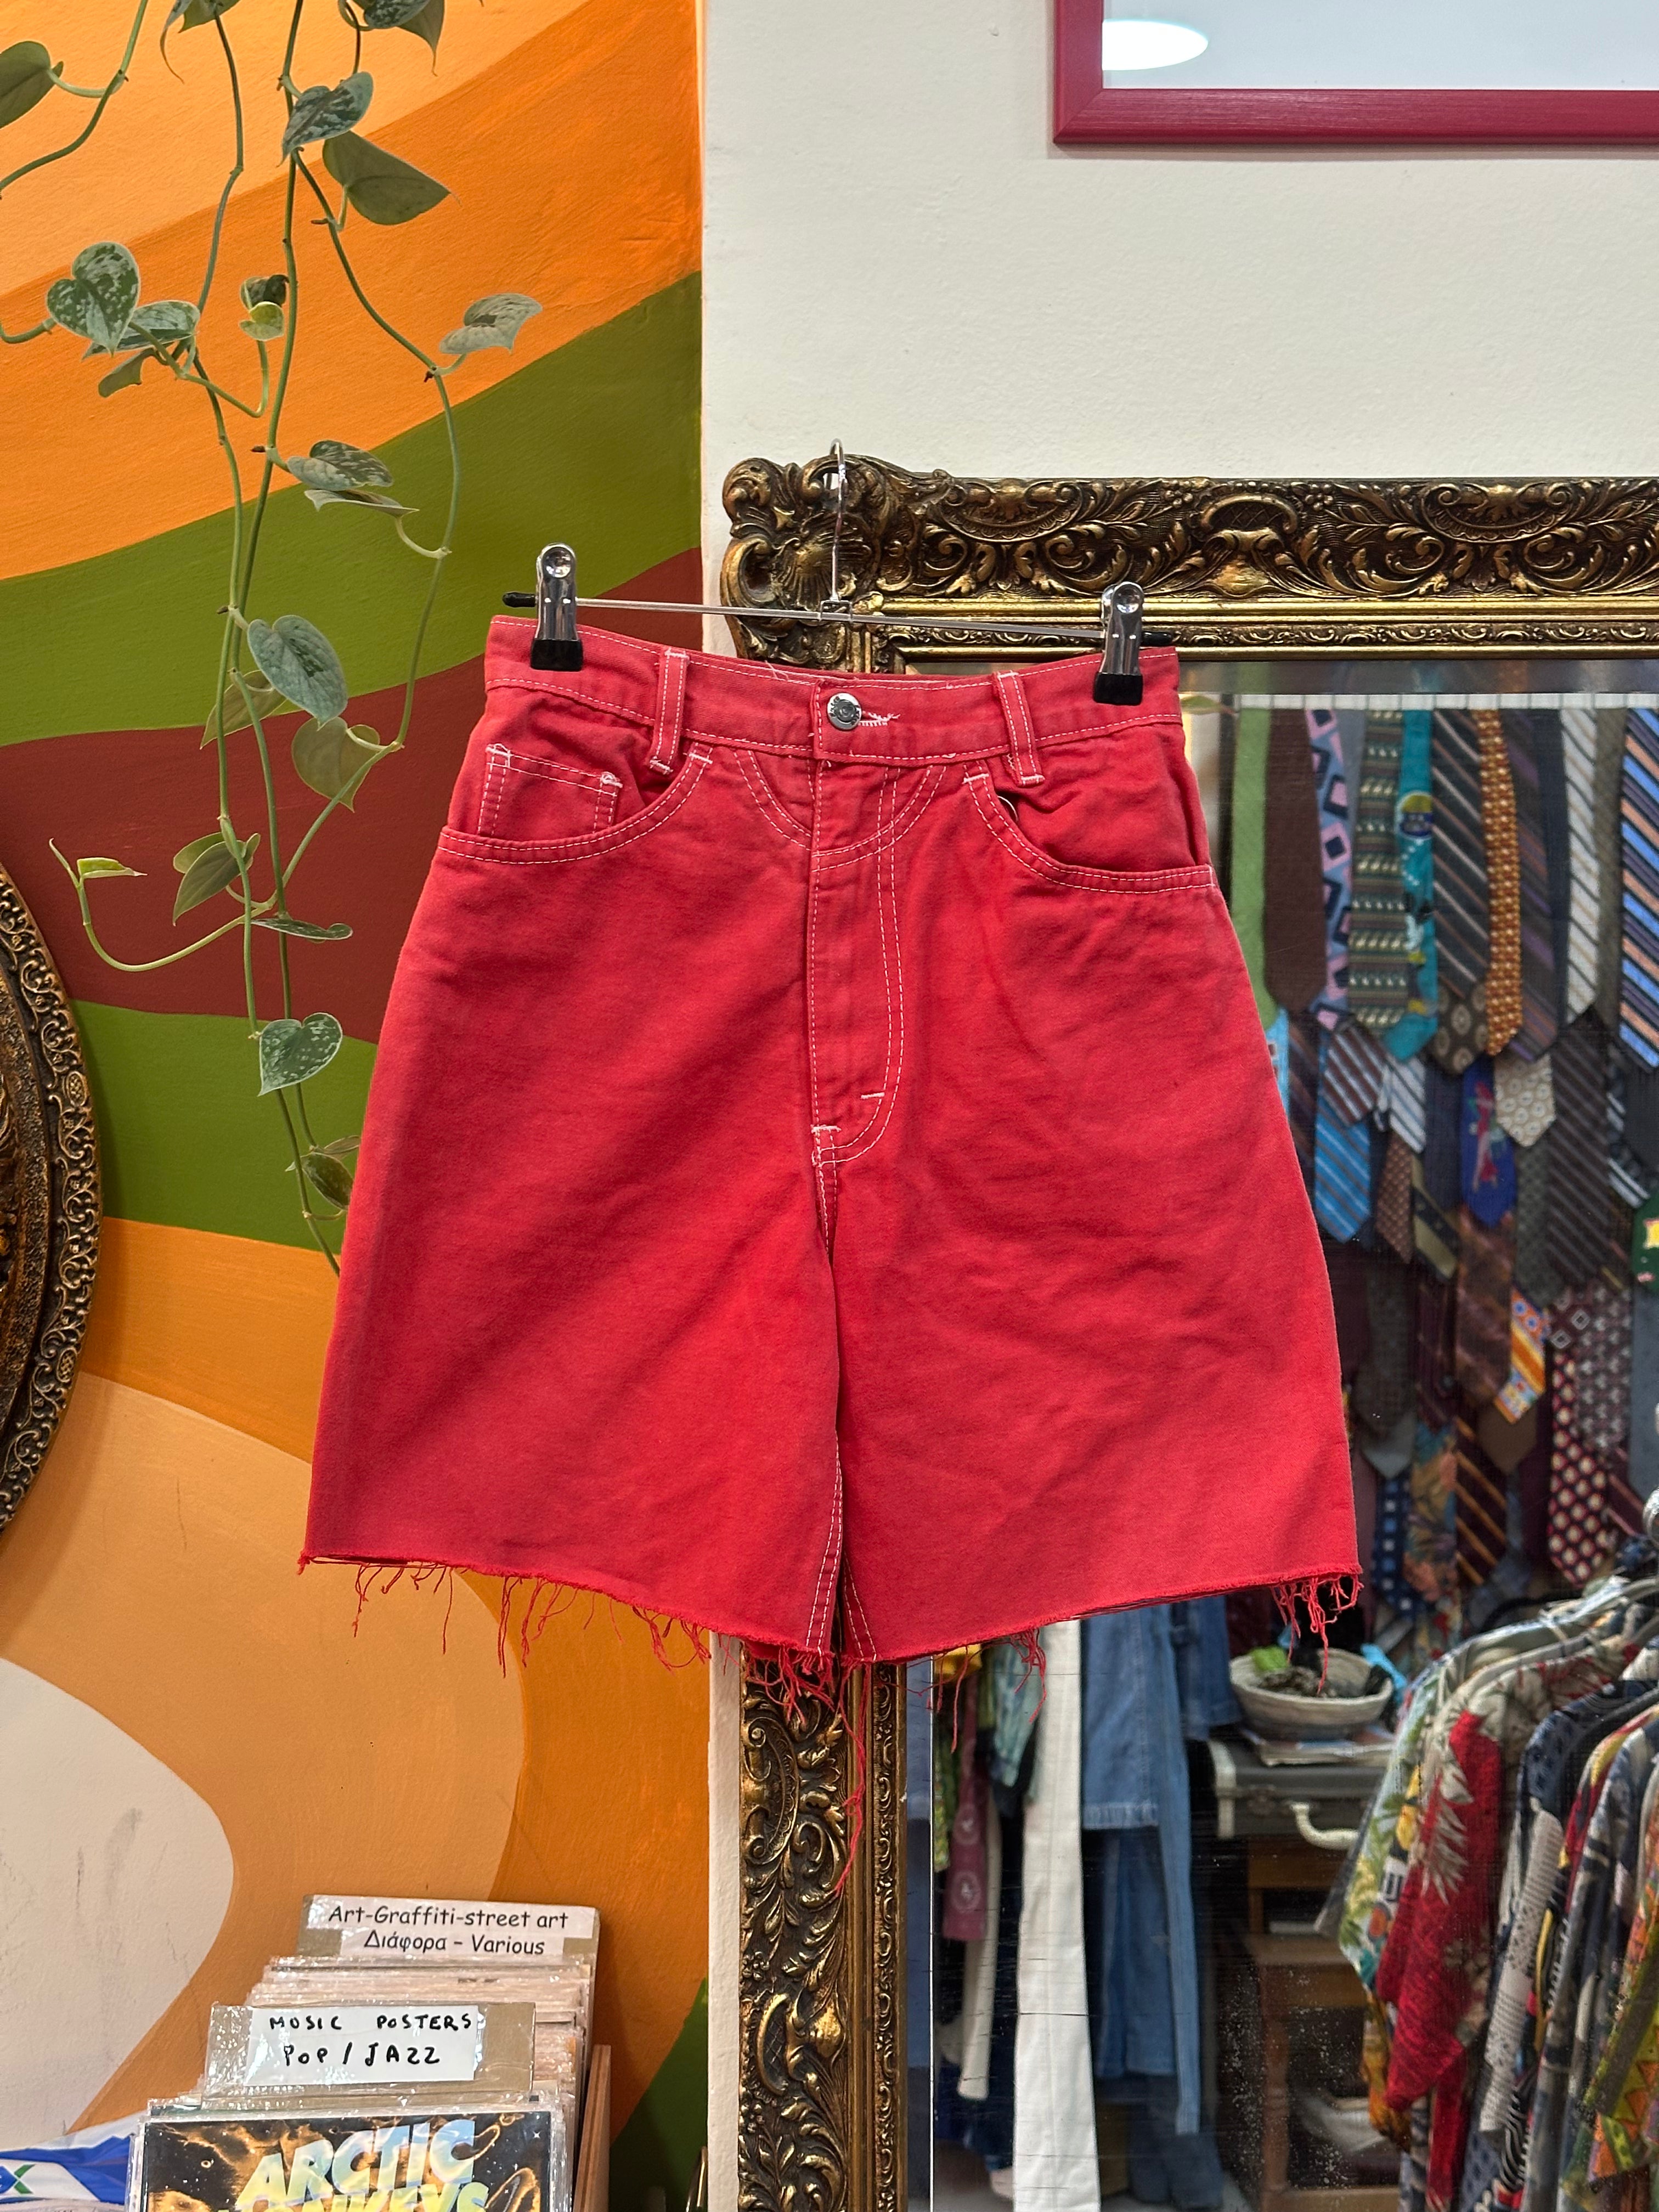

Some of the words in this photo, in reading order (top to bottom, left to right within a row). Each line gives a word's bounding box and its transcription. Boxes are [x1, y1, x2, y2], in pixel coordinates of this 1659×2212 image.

[328, 1906, 531, 1927] Art-Graffiti-street
[536, 1912, 568, 1928] art
[363, 1930, 447, 1953] Διάφορα
[472, 1934, 545, 1955] Various
[377, 2013, 472, 2031] POSTERS
[235, 2119, 475, 2209] ARCTIC
